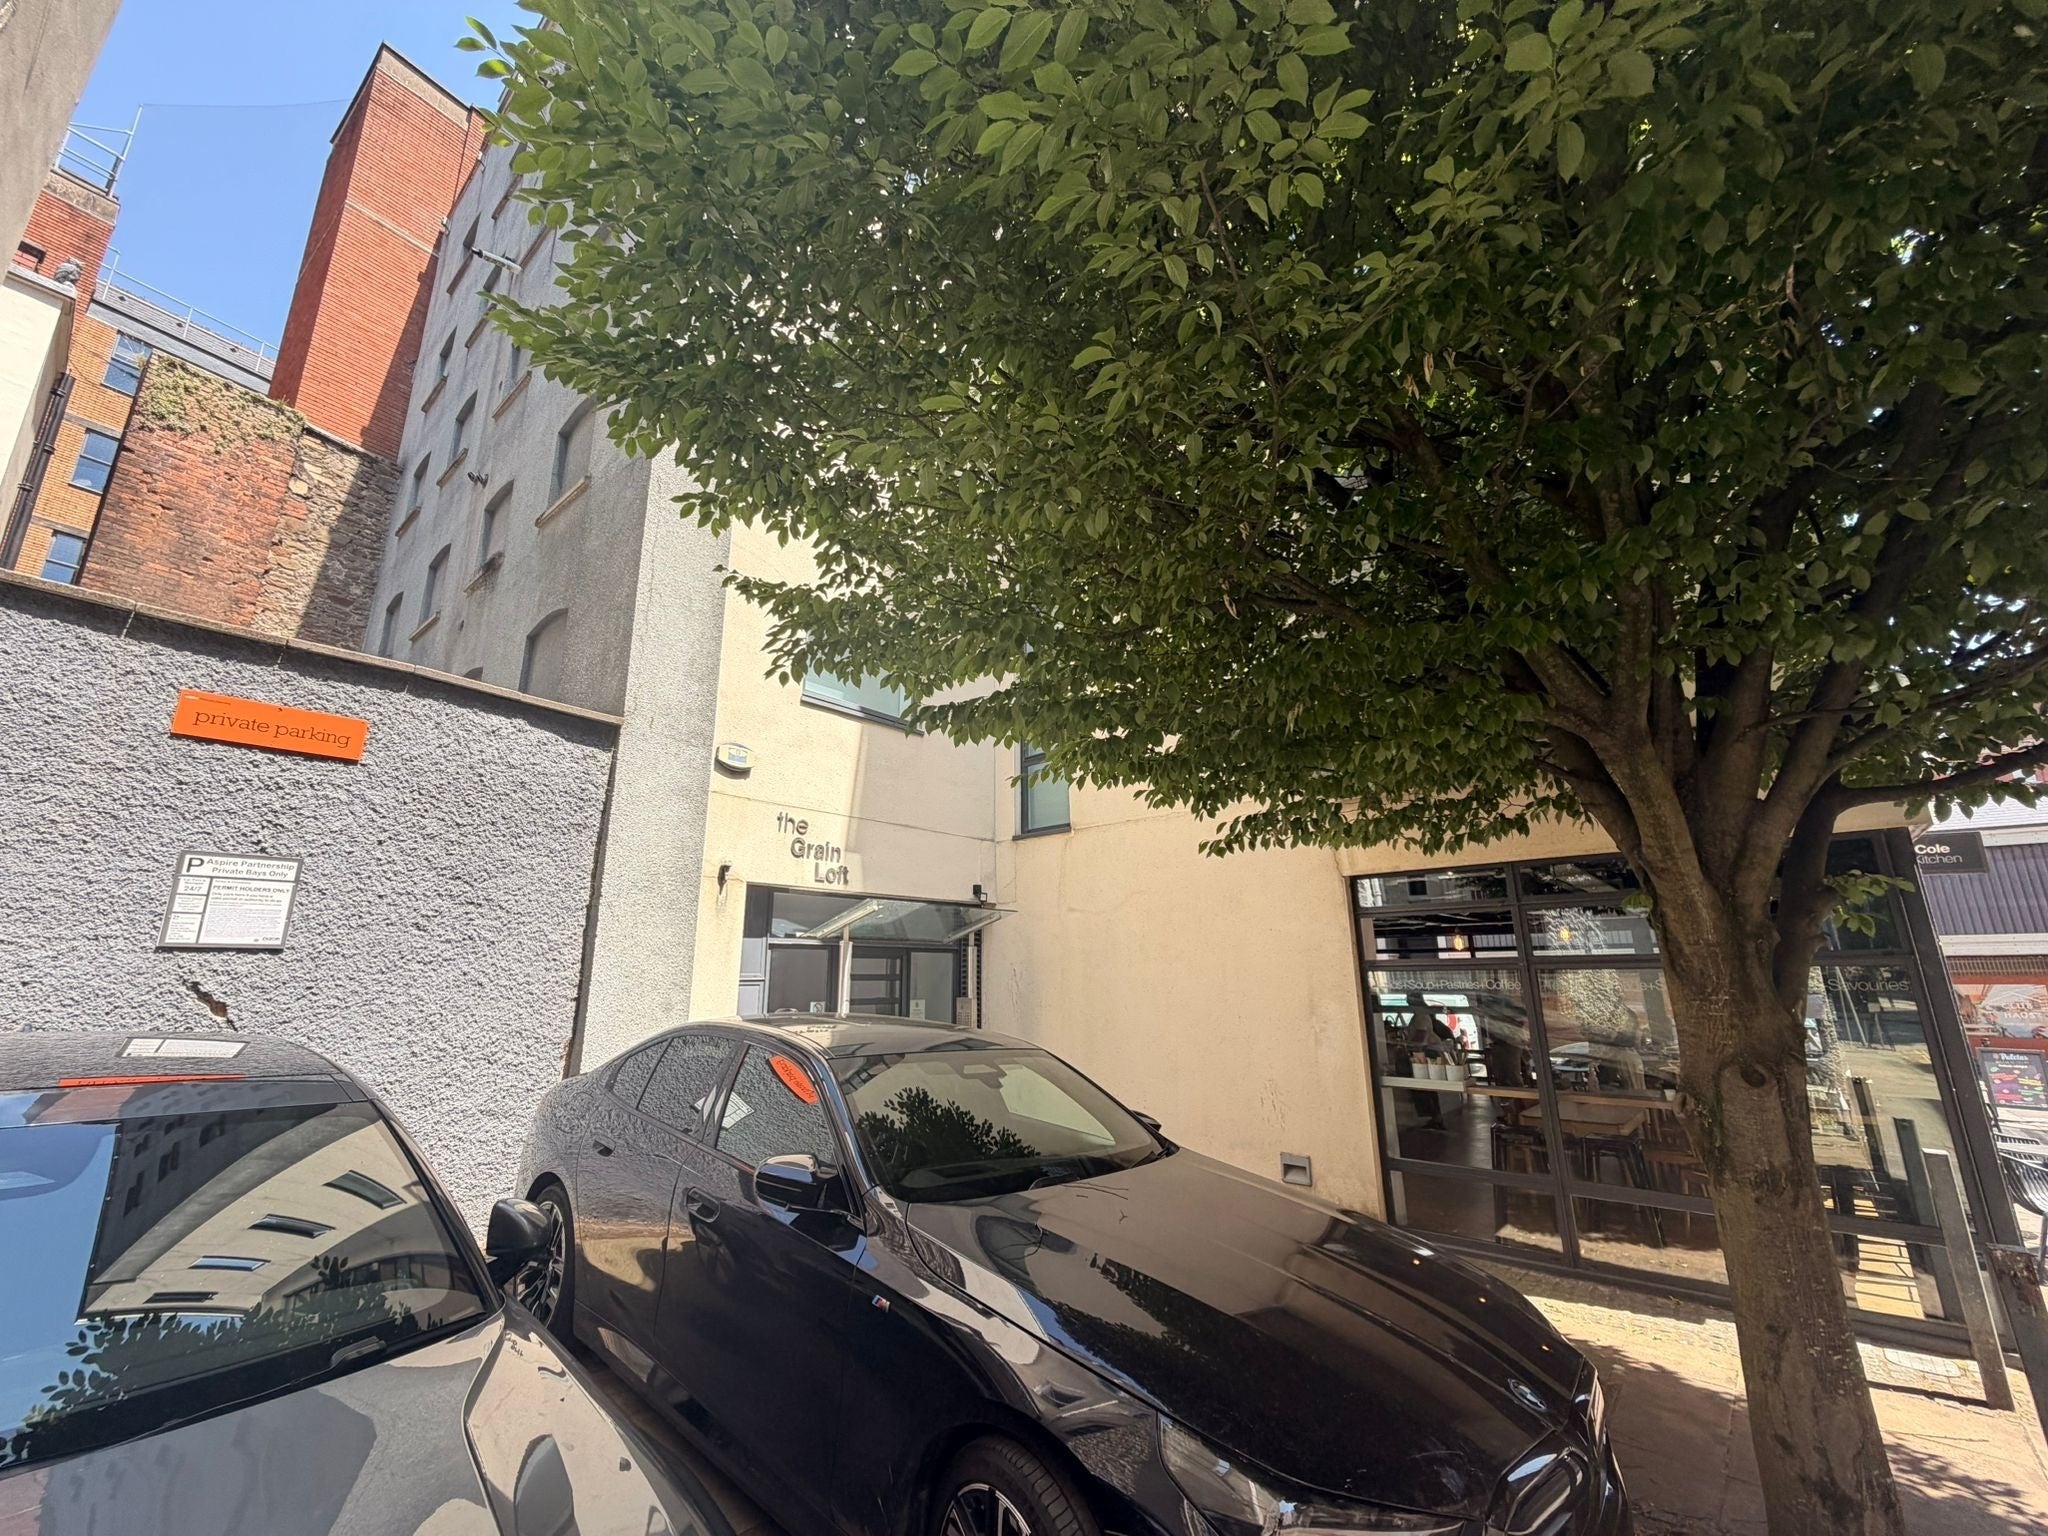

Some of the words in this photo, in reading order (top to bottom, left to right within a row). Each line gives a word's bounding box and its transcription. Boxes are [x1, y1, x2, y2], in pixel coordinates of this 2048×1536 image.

[192, 711, 270, 734] private
[273, 723, 351, 749] parking
[776, 811, 809, 836] the
[790, 837, 841, 864] Grain
[1914, 843, 1951, 855] Cole
[186, 857, 205, 873] P
[206, 858, 239, 867] Aspire
[241, 860, 295, 871] Partnership
[211, 867, 244, 876] Private
[246, 869, 267, 878] Bays
[268, 870, 289, 879] Only
[814, 862, 849, 886] Loft
